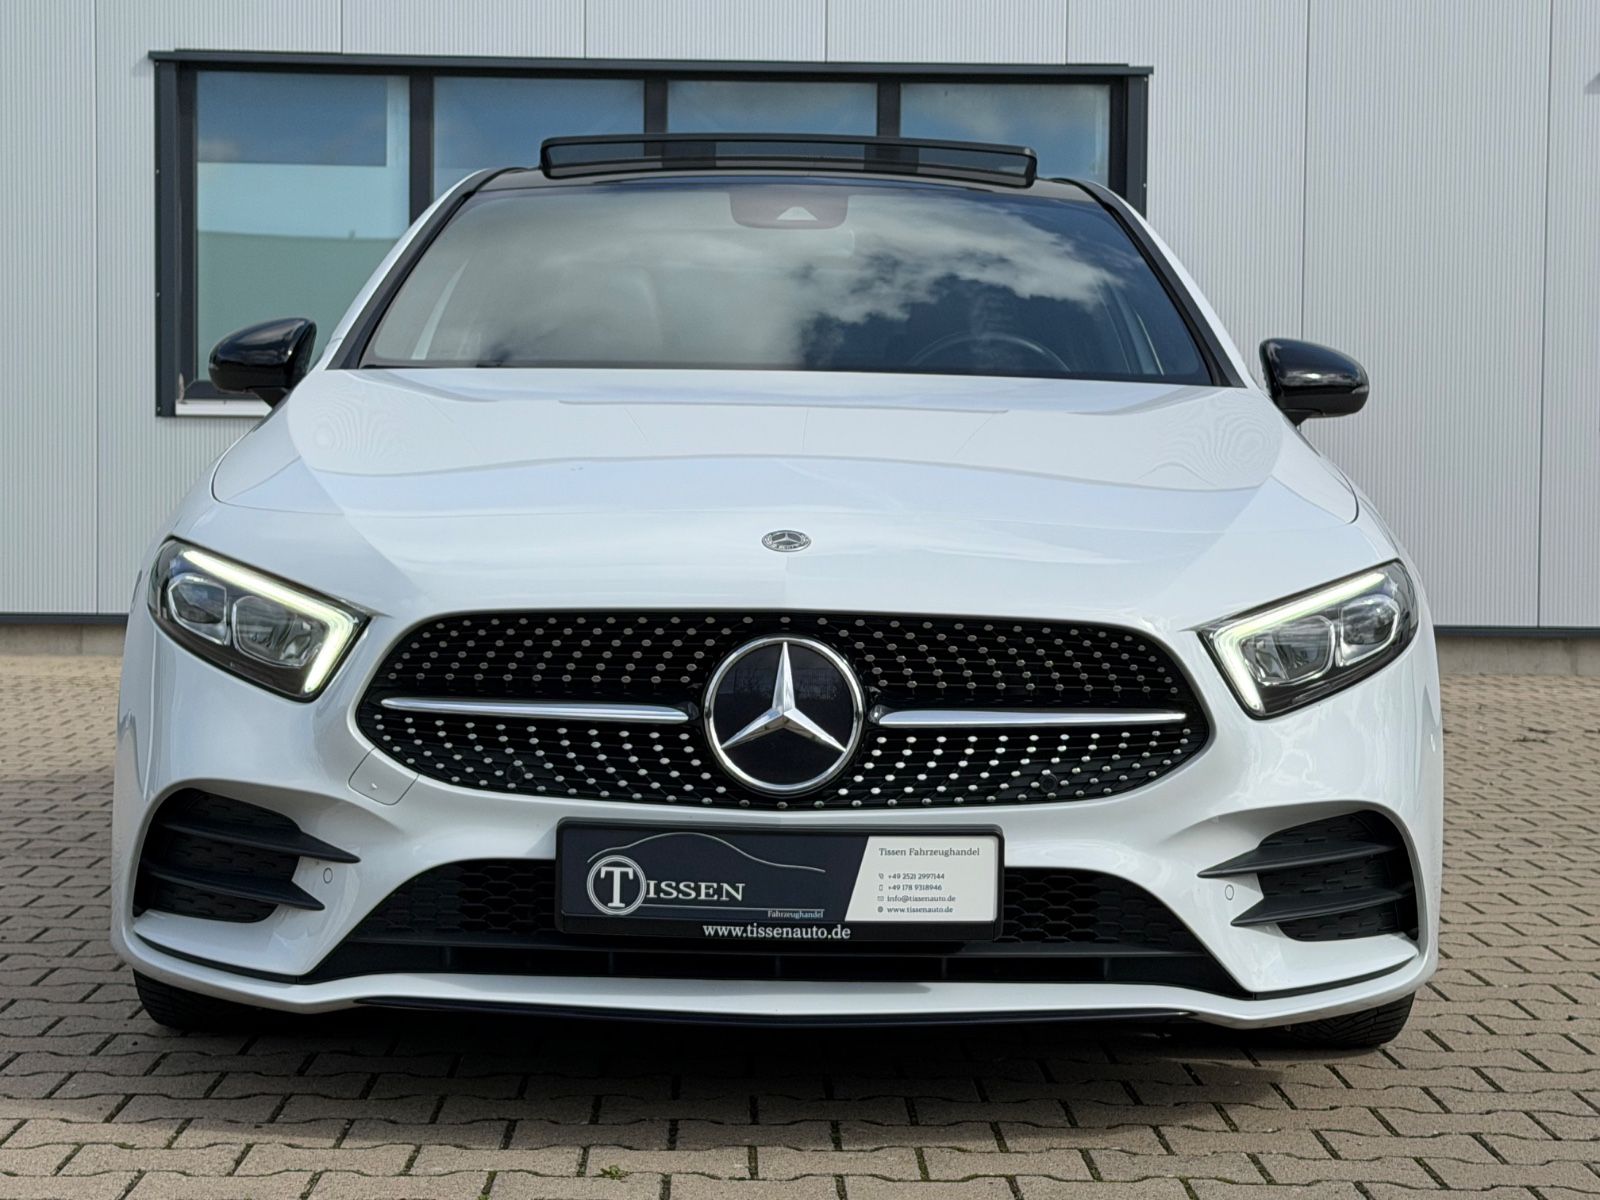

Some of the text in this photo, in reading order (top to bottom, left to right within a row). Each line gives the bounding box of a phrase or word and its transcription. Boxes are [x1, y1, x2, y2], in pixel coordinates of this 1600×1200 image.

[879, 847, 980, 858] Tissen Fahrzeughandel
[600, 866, 746, 908] TISSEN
[767, 910, 824, 919] Fahrzeughandel
[702, 923, 851, 939] www.tissenauto.de
